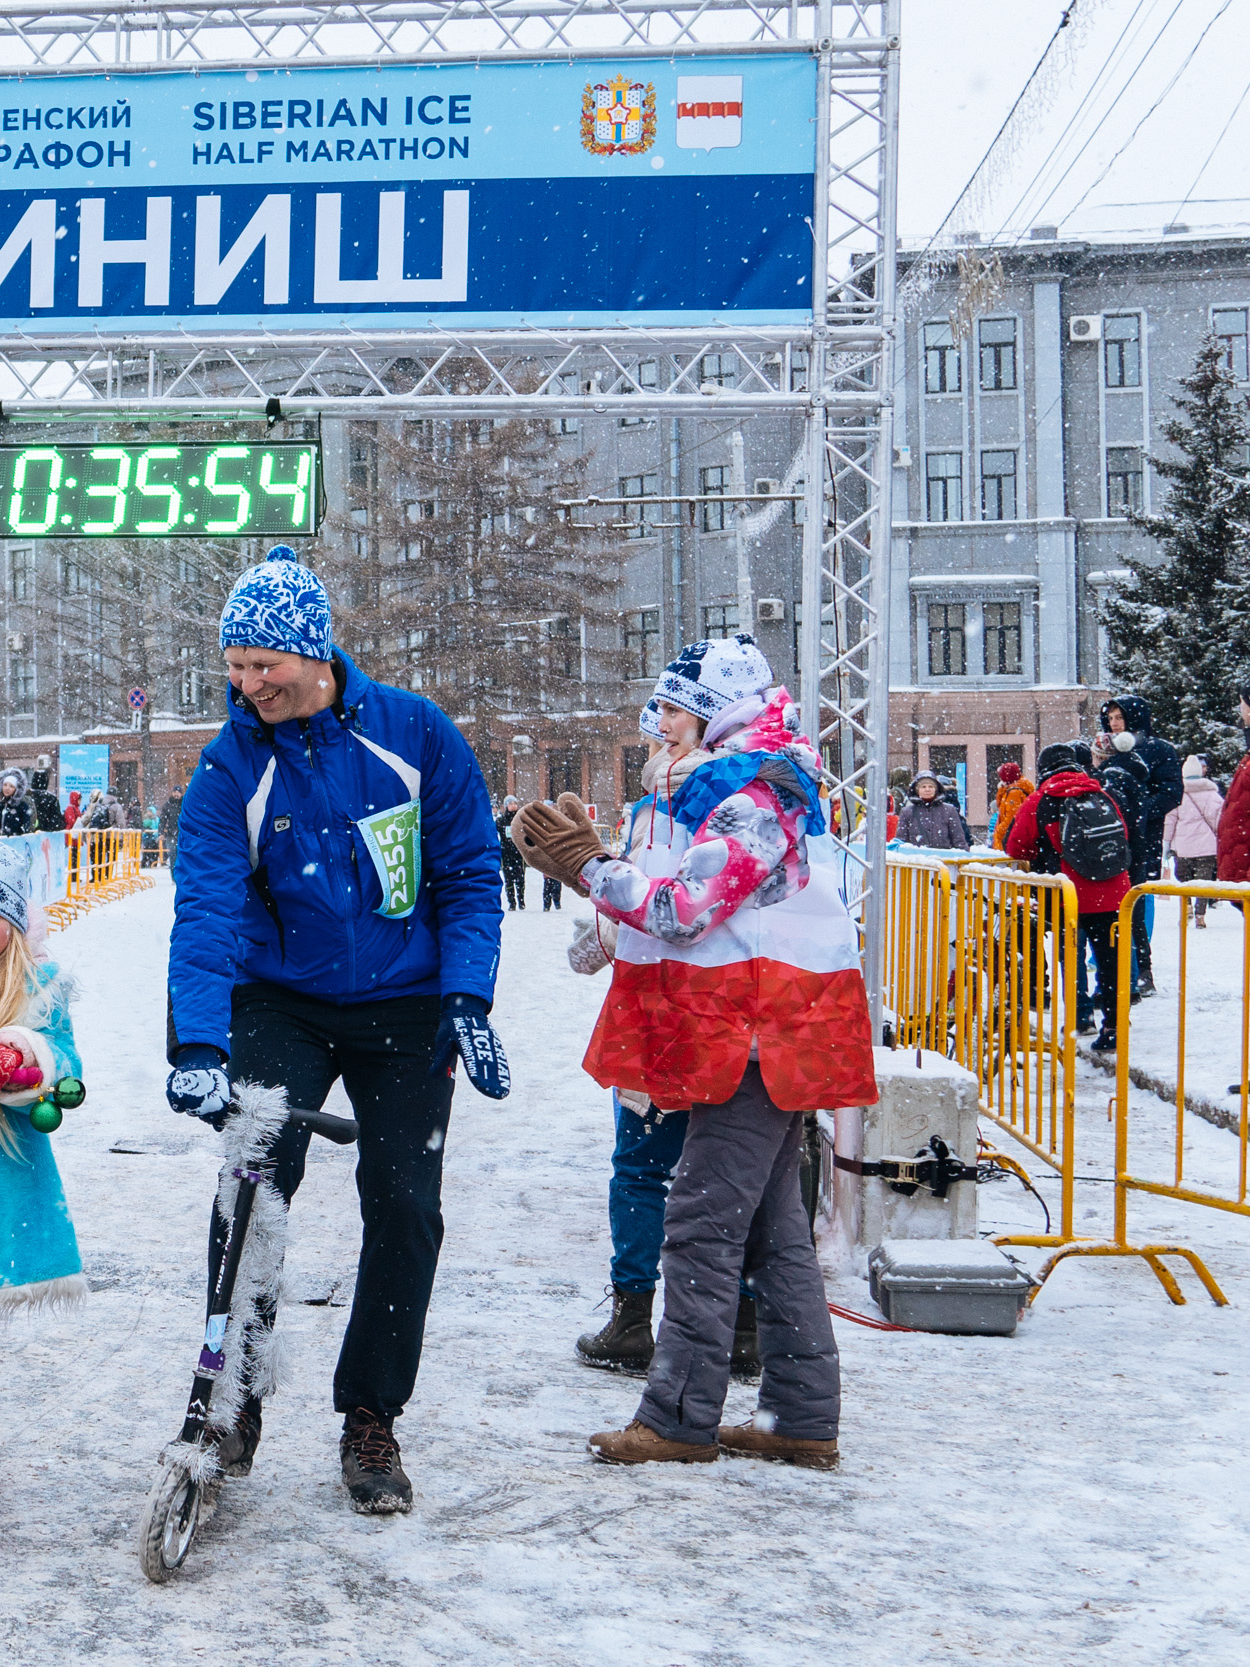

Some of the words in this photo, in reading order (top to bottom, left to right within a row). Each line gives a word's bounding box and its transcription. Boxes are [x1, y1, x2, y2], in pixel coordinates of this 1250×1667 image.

[192, 97, 388, 131] SIBERIAN
[405, 94, 472, 125] ICE
[192, 142, 275, 165] HALF
[285, 135, 471, 163] MARATHON
[7, 446, 312, 535] 0:35:54
[375, 823, 409, 910] 2355
